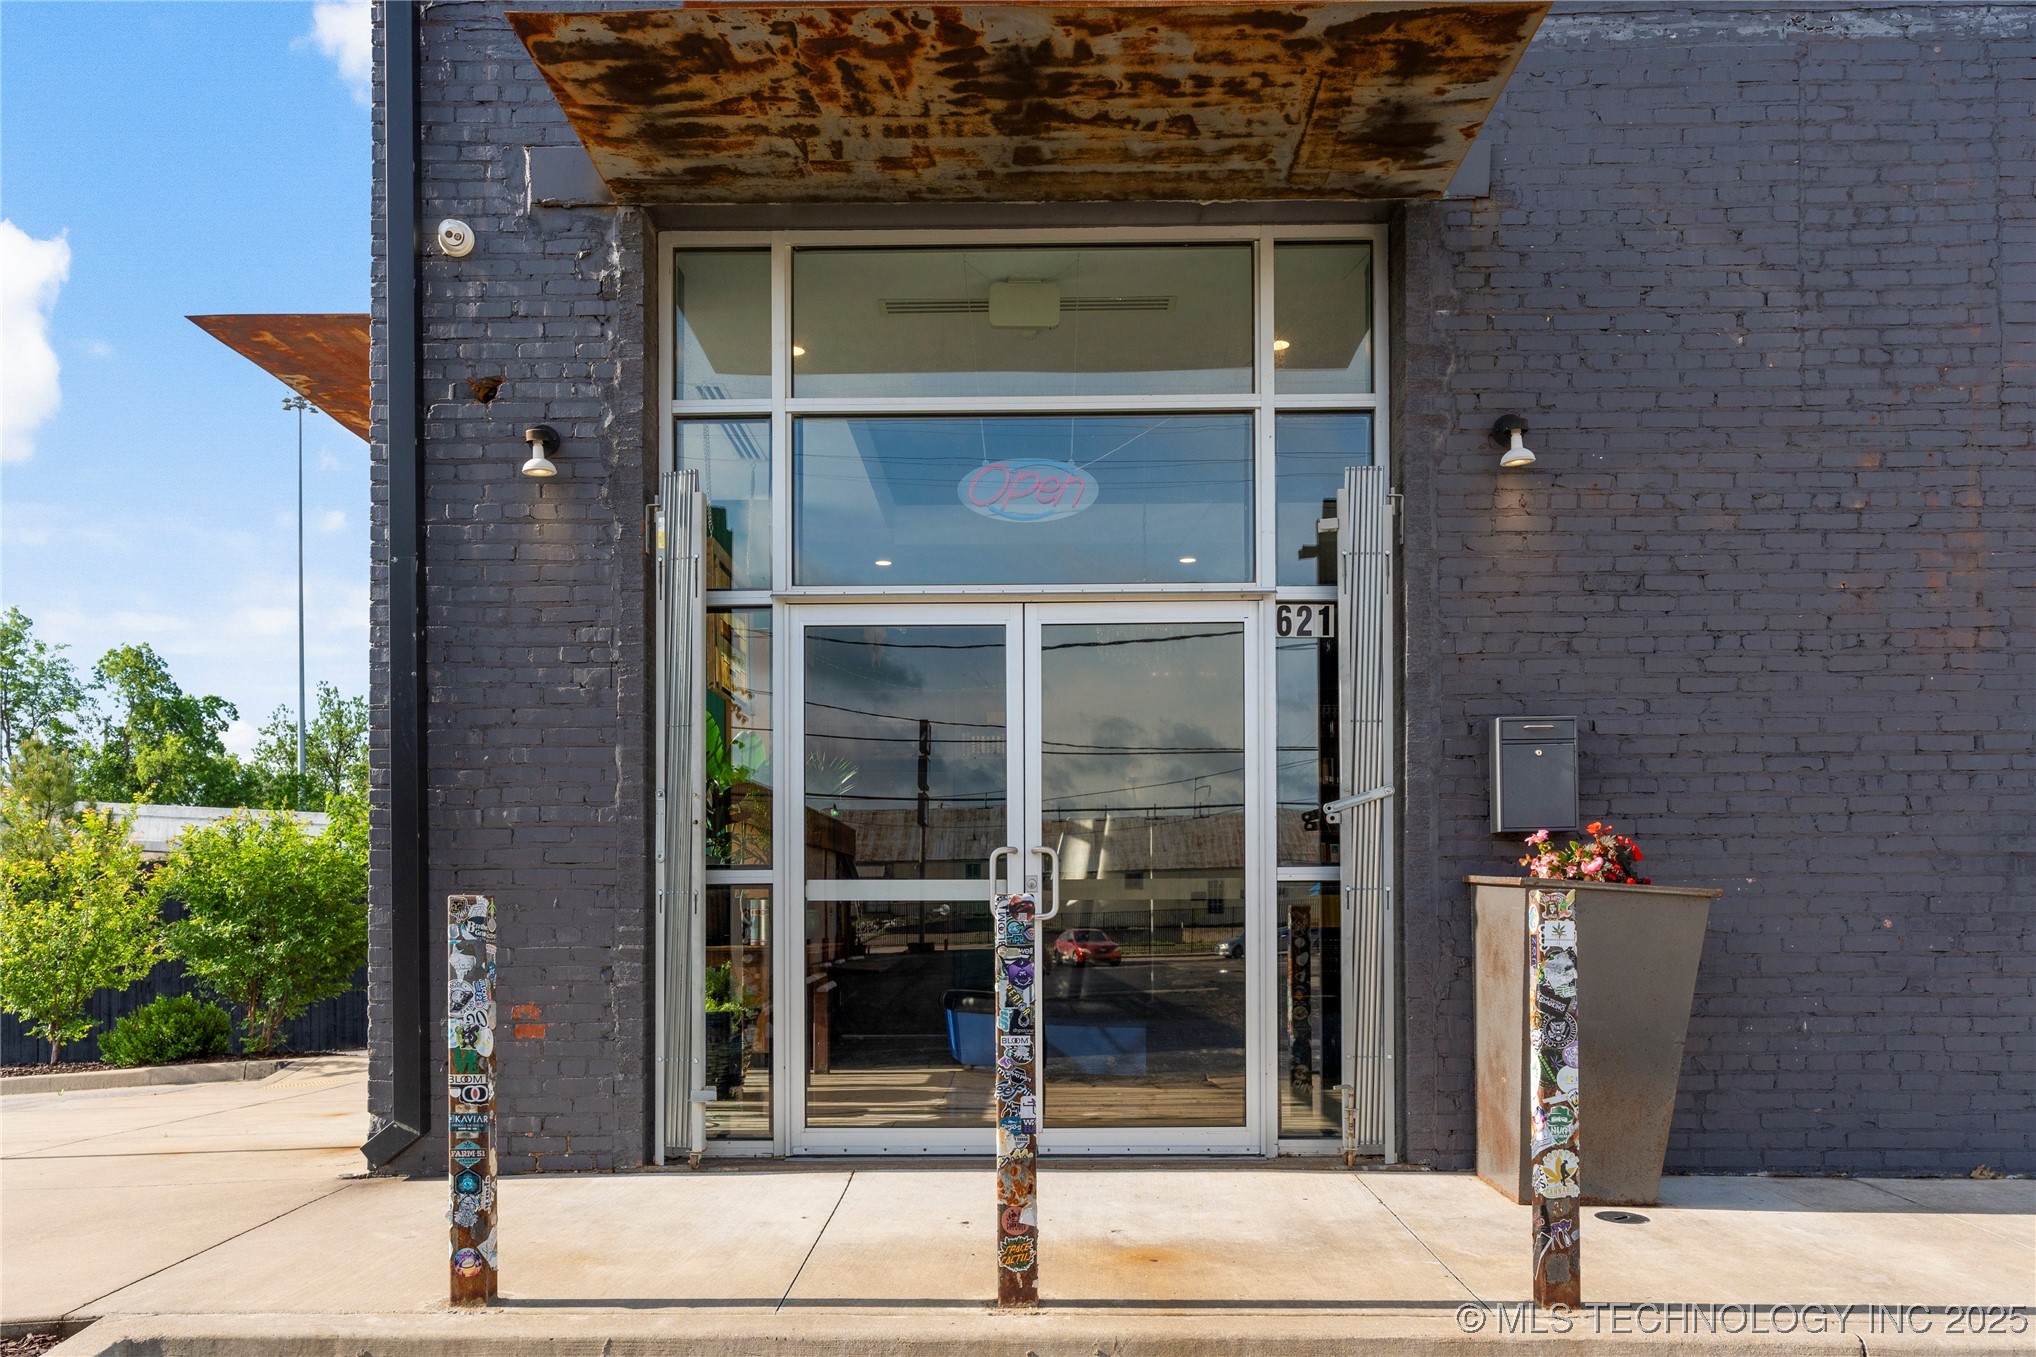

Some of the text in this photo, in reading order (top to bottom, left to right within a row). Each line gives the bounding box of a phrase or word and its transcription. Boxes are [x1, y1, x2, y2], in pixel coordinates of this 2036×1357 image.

[968, 464, 1085, 511] Open
[1276, 605, 1330, 636] 621
[449, 1075, 483, 1084] BLOOM
[455, 1115, 489, 1123] KAVIAR
[1001, 1242, 1031, 1256] SPACE
[1000, 1253, 1033, 1265] CACTUS
